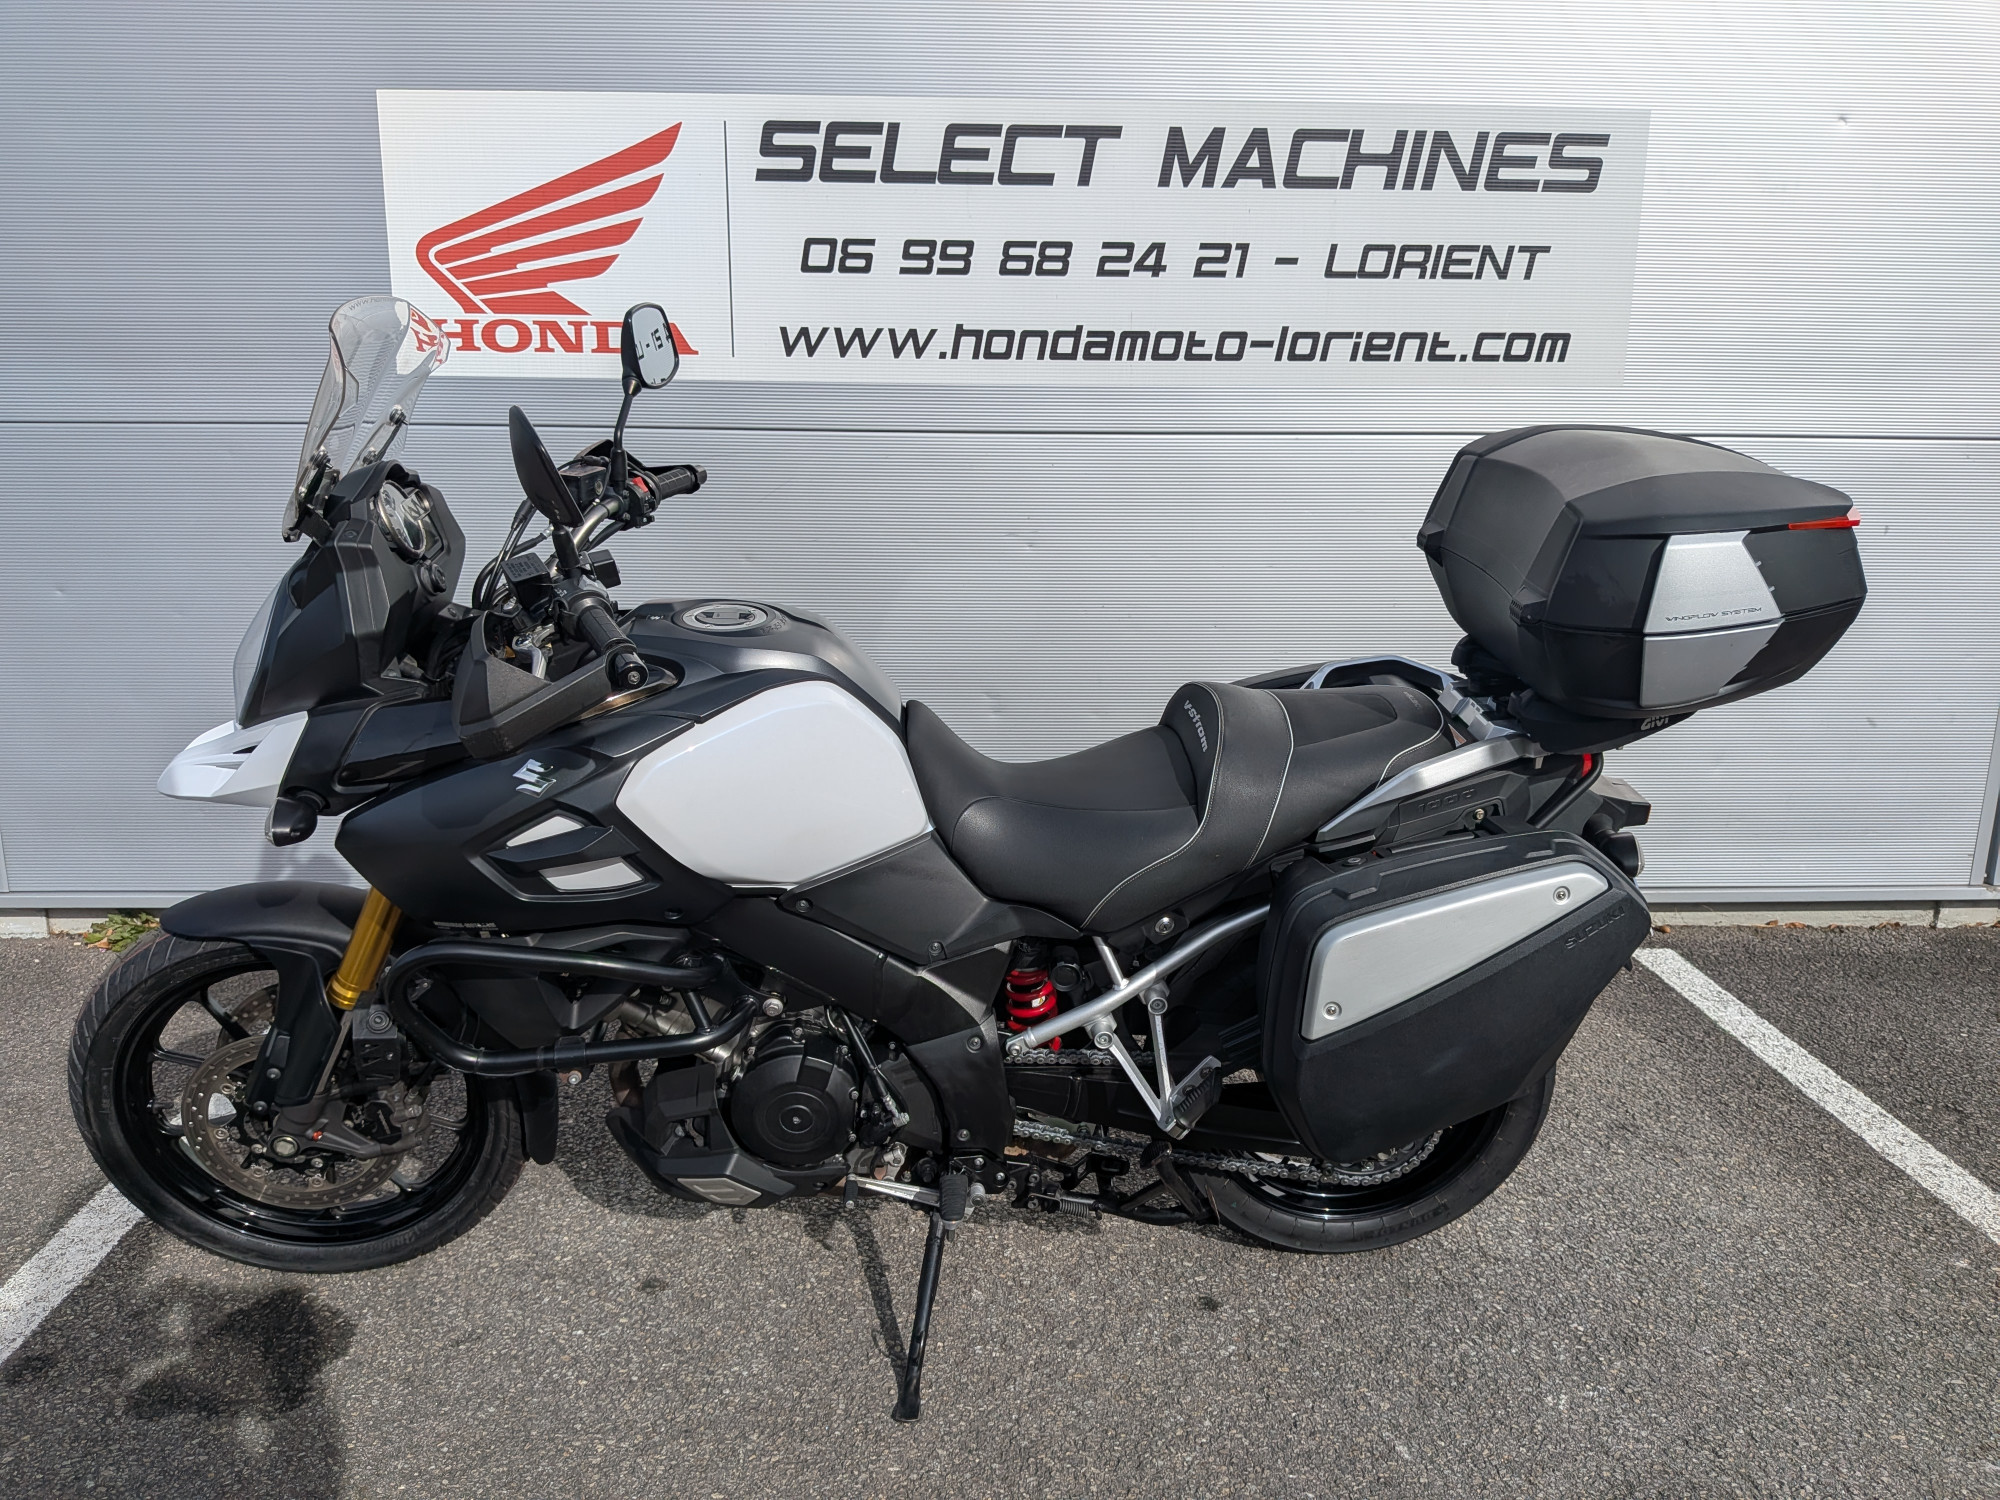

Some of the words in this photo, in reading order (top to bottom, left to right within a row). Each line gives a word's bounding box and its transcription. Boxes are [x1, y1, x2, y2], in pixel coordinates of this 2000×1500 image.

[756, 121, 1123, 187] SELECT
[1157, 126, 1611, 194] MACHINES
[800, 237, 876, 274] 06
[899, 239, 975, 276] 99
[998, 240, 1074, 277] 68
[1096, 241, 1168, 278] 24
[1193, 242, 1250, 278] 21
[1274, 257, 1299, 265] -
[1324, 243, 1552, 280] LORIENT
[779, 323, 1572, 363] www.hondamoto-lorient.com
[1721, 607, 1762, 616] SYSTEM
[1640, 716, 1669, 731] GIVI
[1565, 905, 1626, 950] SUZUKI
